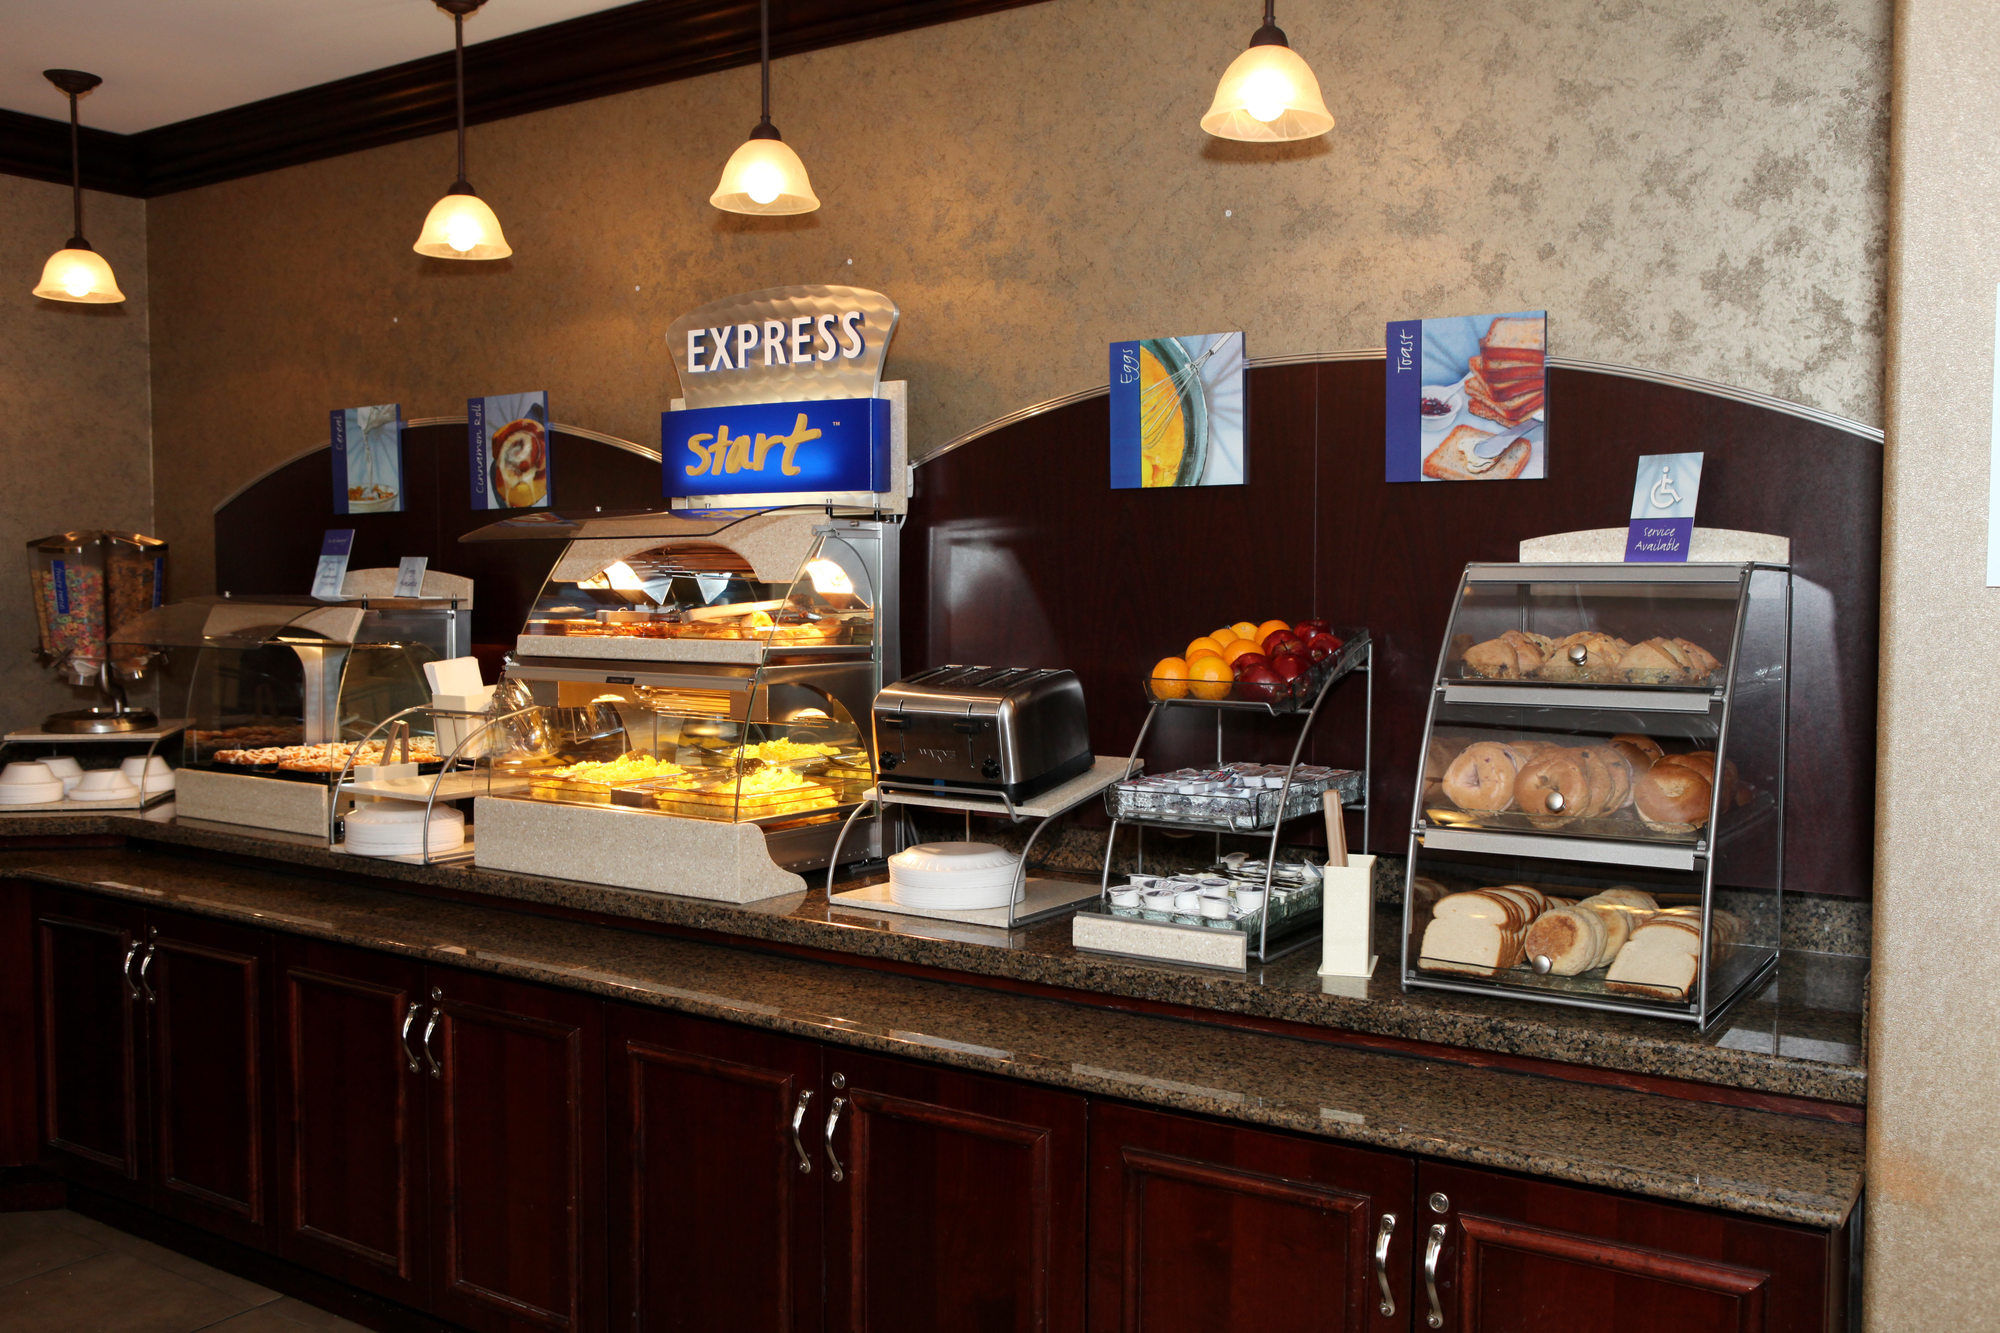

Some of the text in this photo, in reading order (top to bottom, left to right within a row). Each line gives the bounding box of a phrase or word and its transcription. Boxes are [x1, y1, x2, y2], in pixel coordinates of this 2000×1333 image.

[687, 311, 866, 373] EXPRESS
[1397, 330, 1413, 373] Toast
[1120, 349, 1140, 384] Eggs
[473, 403, 485, 494] Cinnamon Roll
[1635, 538, 1680, 552] Available
